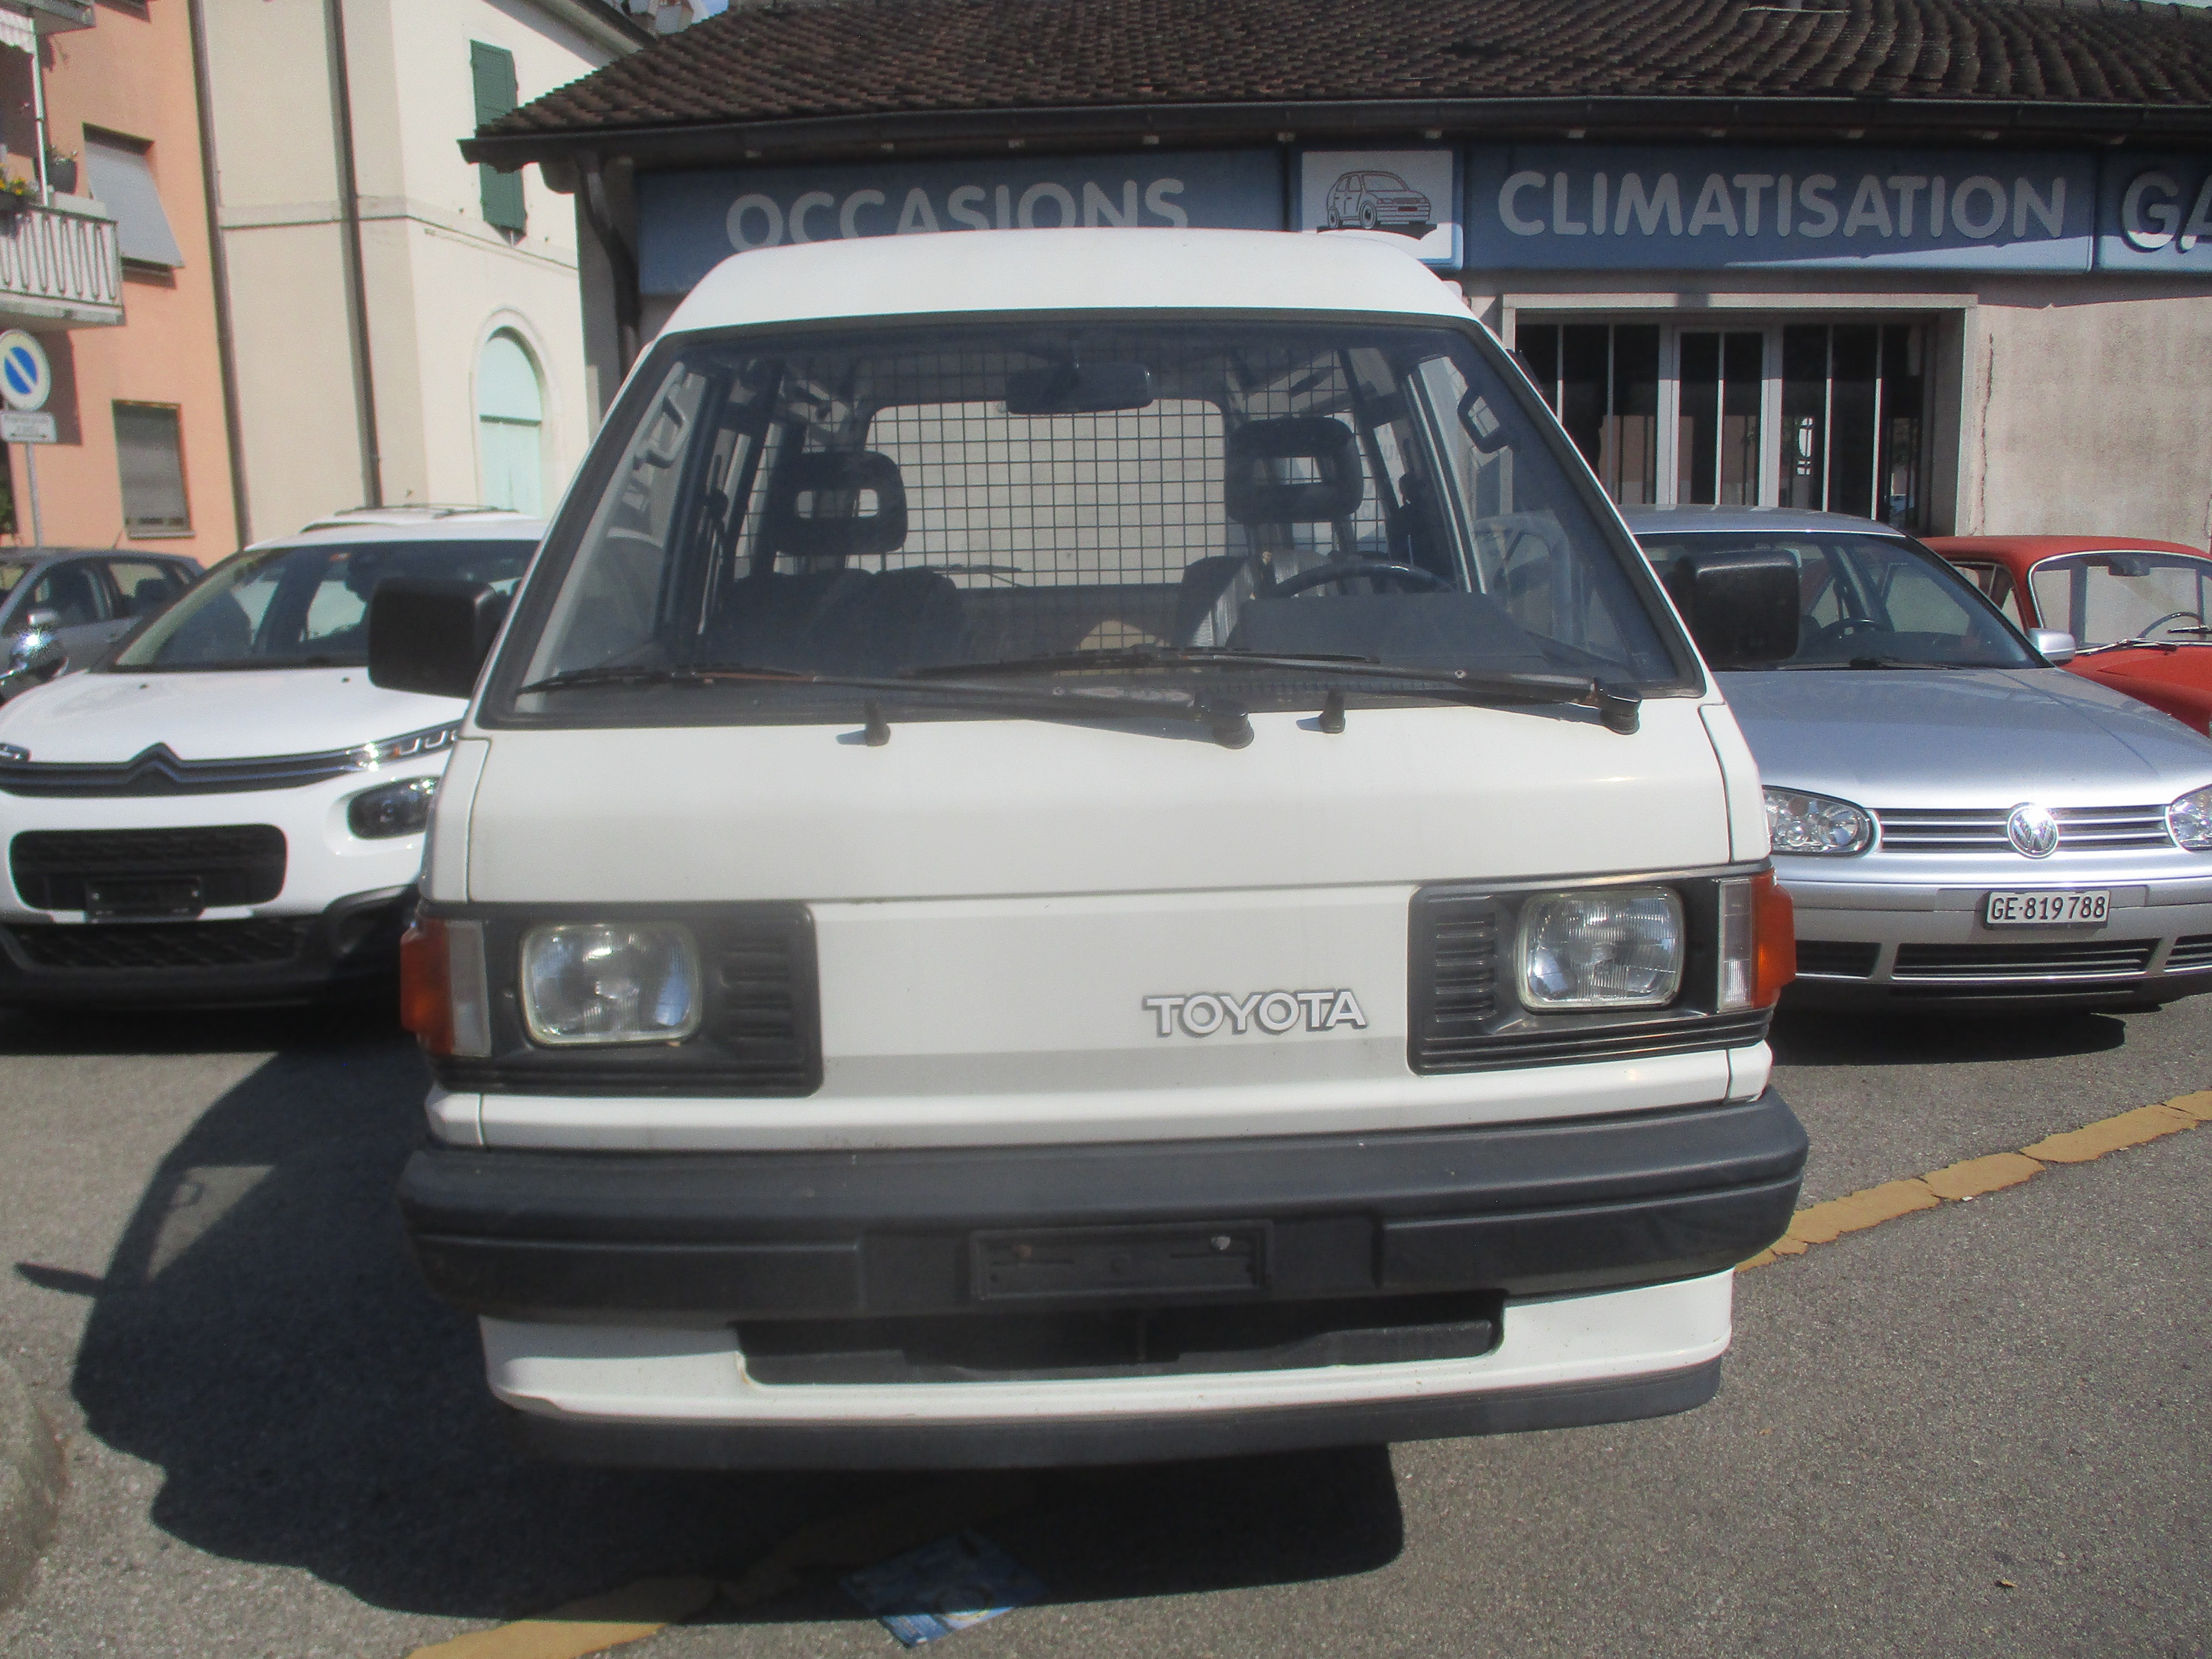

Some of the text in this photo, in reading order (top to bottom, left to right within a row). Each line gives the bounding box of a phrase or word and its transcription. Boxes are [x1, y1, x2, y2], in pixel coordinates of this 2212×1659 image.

[726, 178, 1188, 253] OCCASIONS
[1498, 170, 2066, 240] CLIMATISATION
[1142, 988, 1369, 1038] TOYOTA
